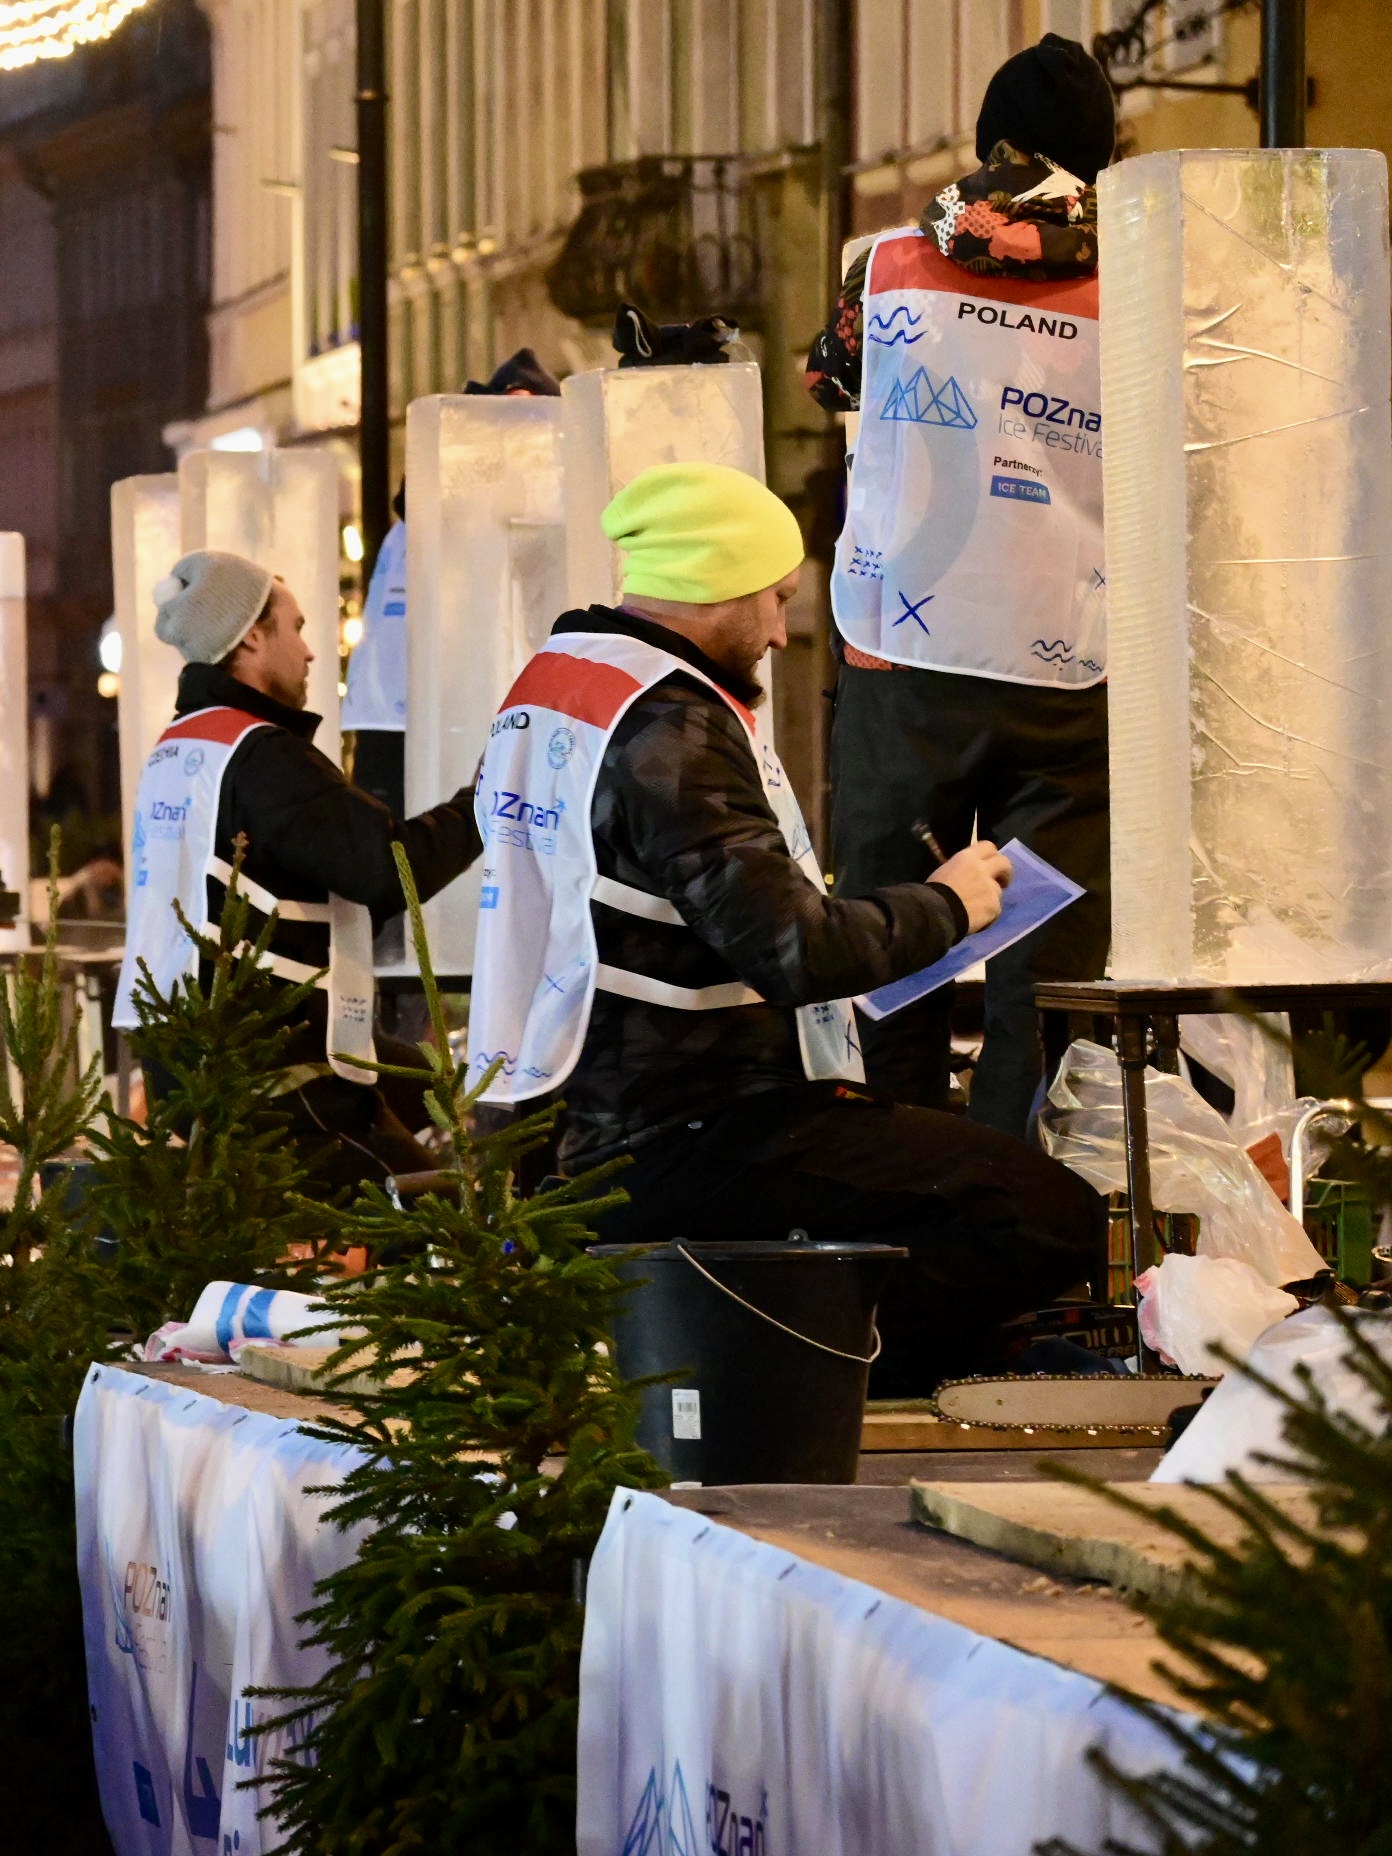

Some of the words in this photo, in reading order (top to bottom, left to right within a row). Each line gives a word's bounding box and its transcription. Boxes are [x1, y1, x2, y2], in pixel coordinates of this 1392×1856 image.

[958, 302, 1078, 341] POLAND
[998, 413, 1027, 440] Ice
[998, 482, 1016, 494] ICE
[1019, 485, 1046, 497] TEAM
